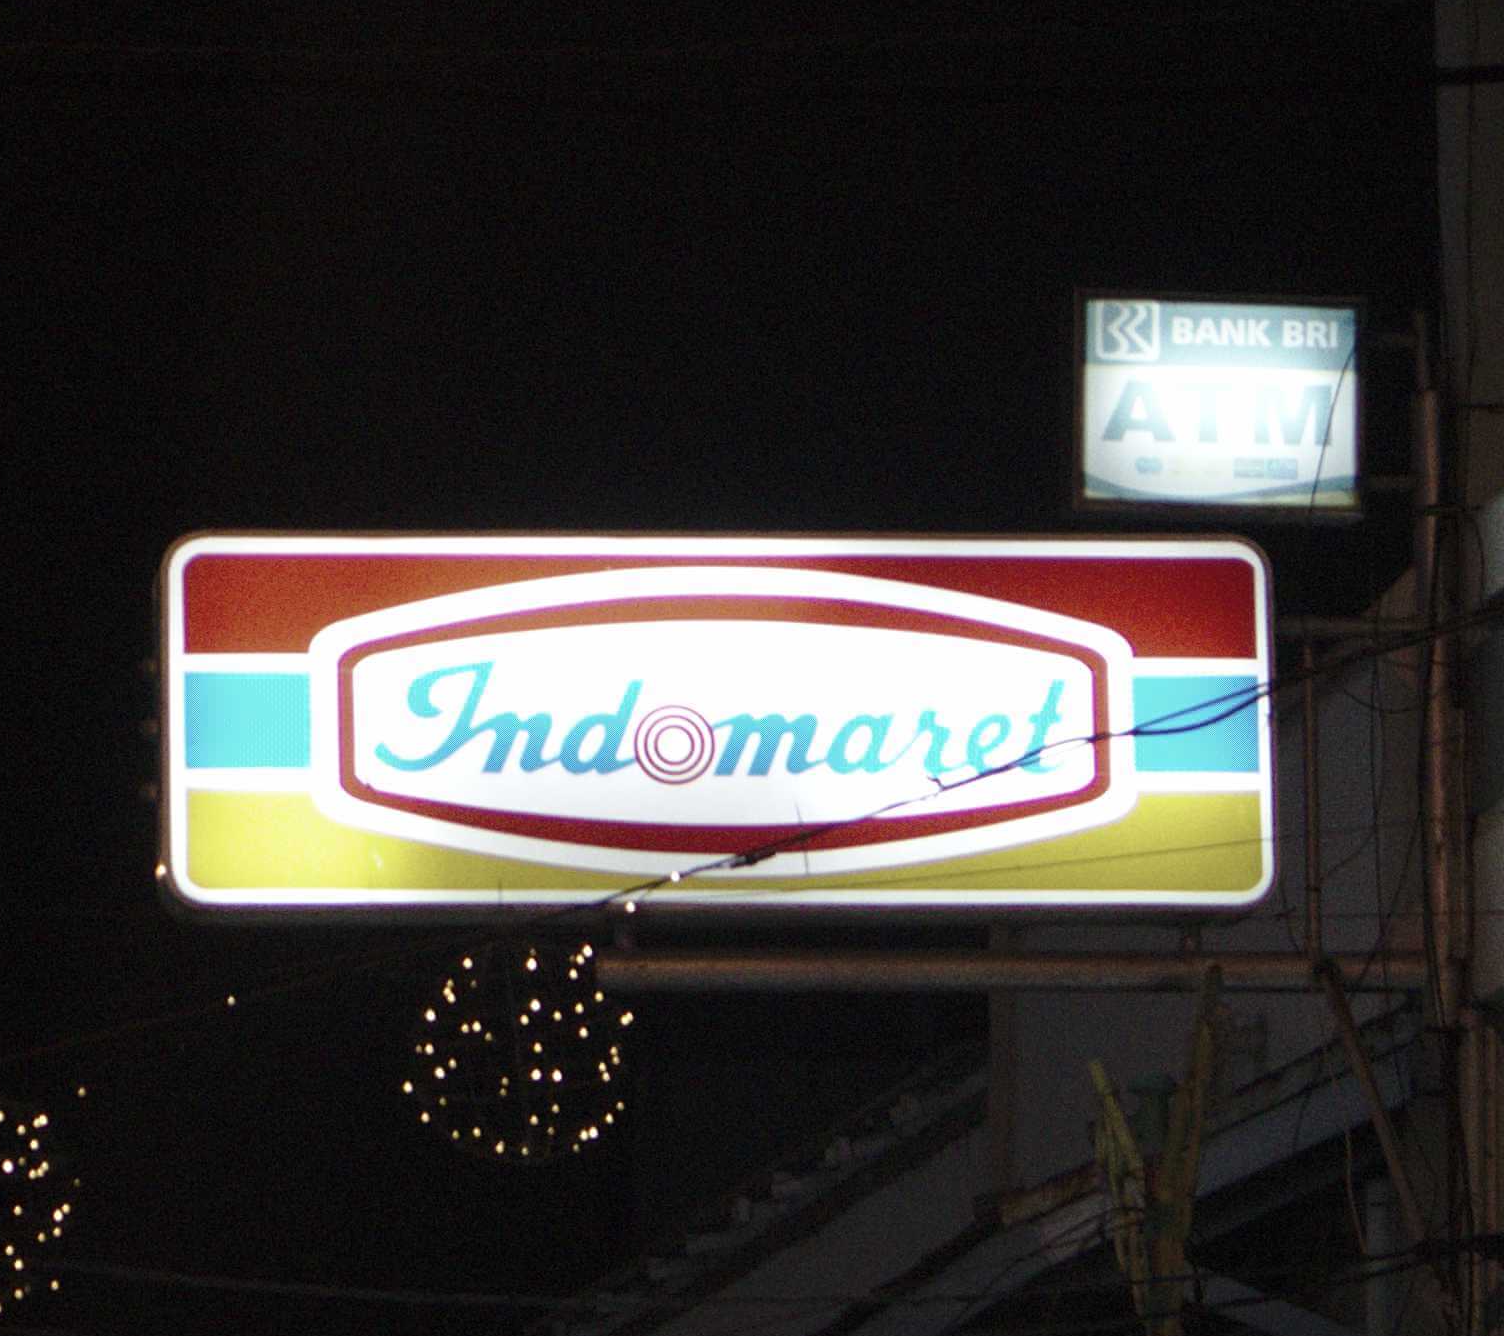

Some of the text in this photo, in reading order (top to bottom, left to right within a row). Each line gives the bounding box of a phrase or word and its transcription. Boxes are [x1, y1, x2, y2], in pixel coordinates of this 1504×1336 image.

[1172, 316, 1340, 350] BANK BRI
[1102, 379, 1334, 447] ATM
[374, 660, 1066, 786] Indomaret
